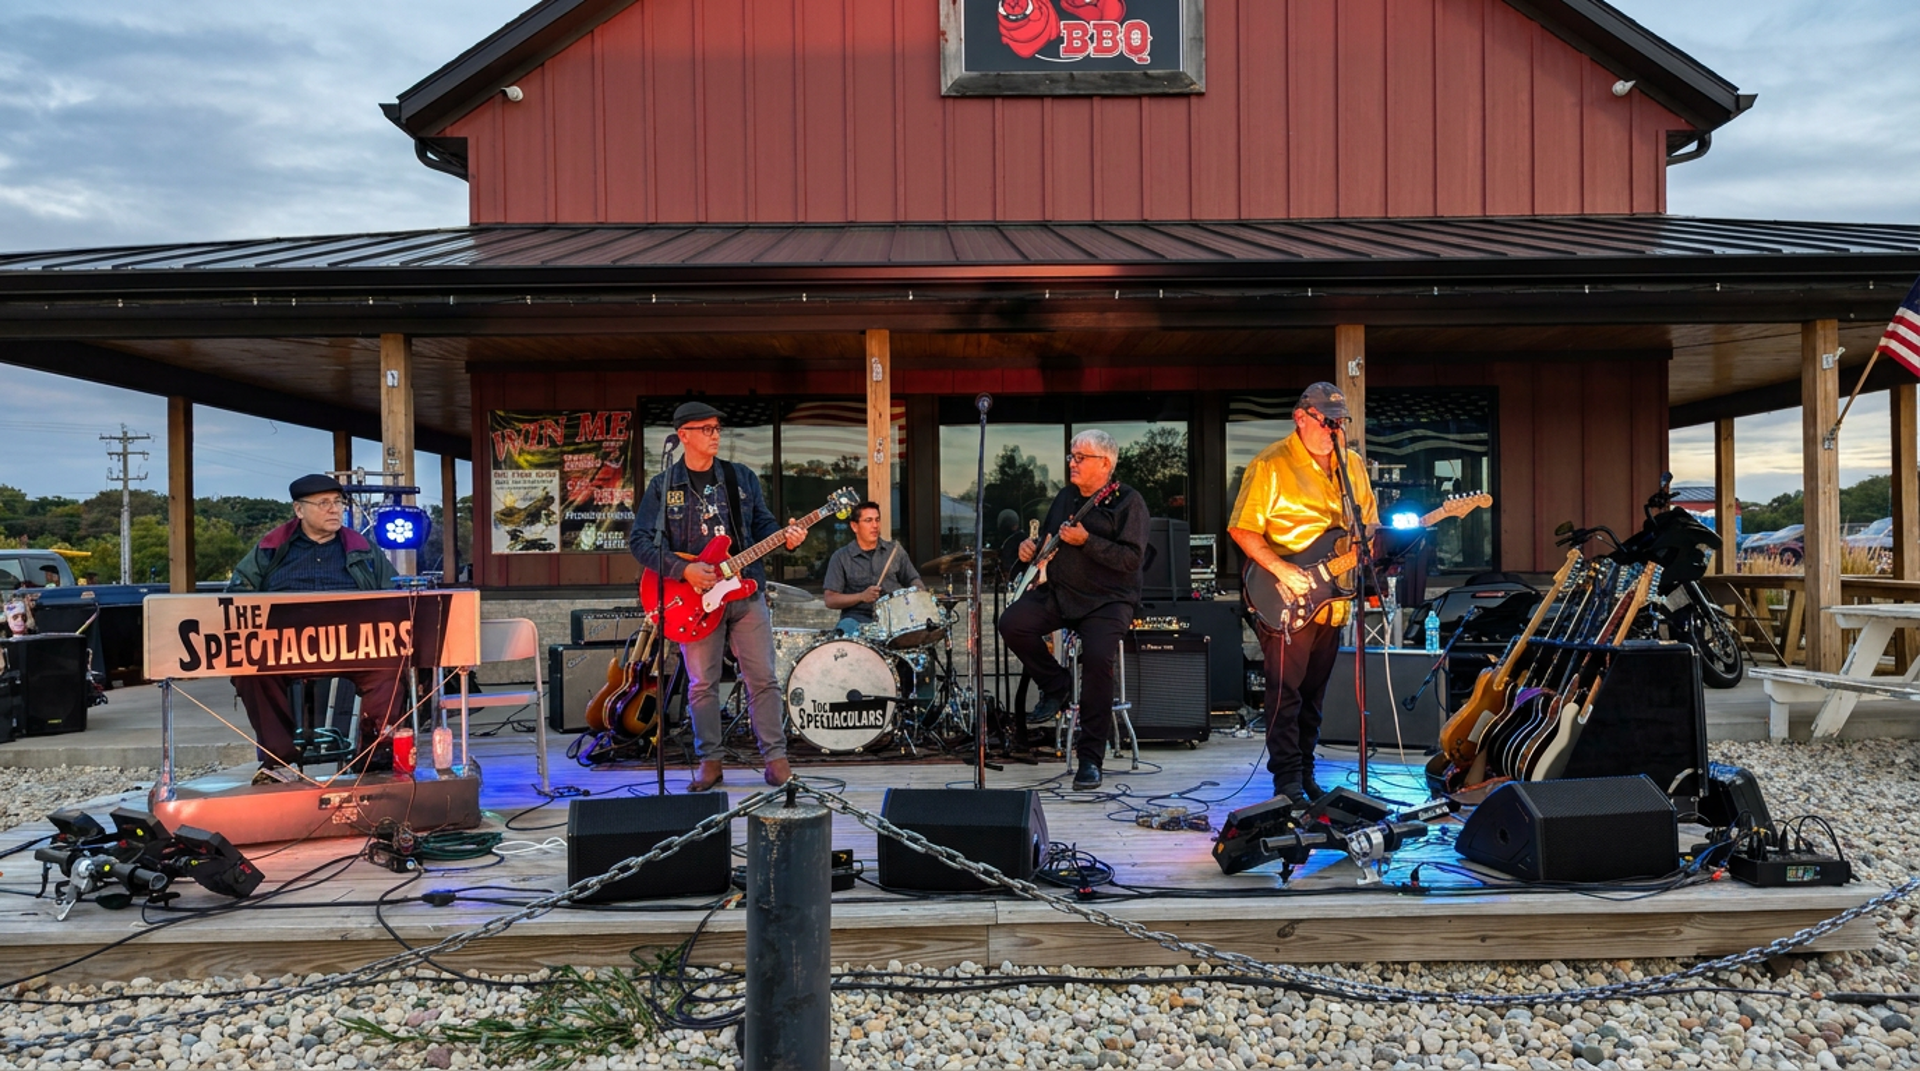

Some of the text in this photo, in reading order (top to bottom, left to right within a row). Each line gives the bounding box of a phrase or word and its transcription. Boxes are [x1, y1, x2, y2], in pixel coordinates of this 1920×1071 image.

[1060, 19, 1153, 64] BBQ
[492, 411, 632, 461] WIN ME
[218, 597, 263, 631] THE
[178, 618, 414, 673] SPECTACULARS
